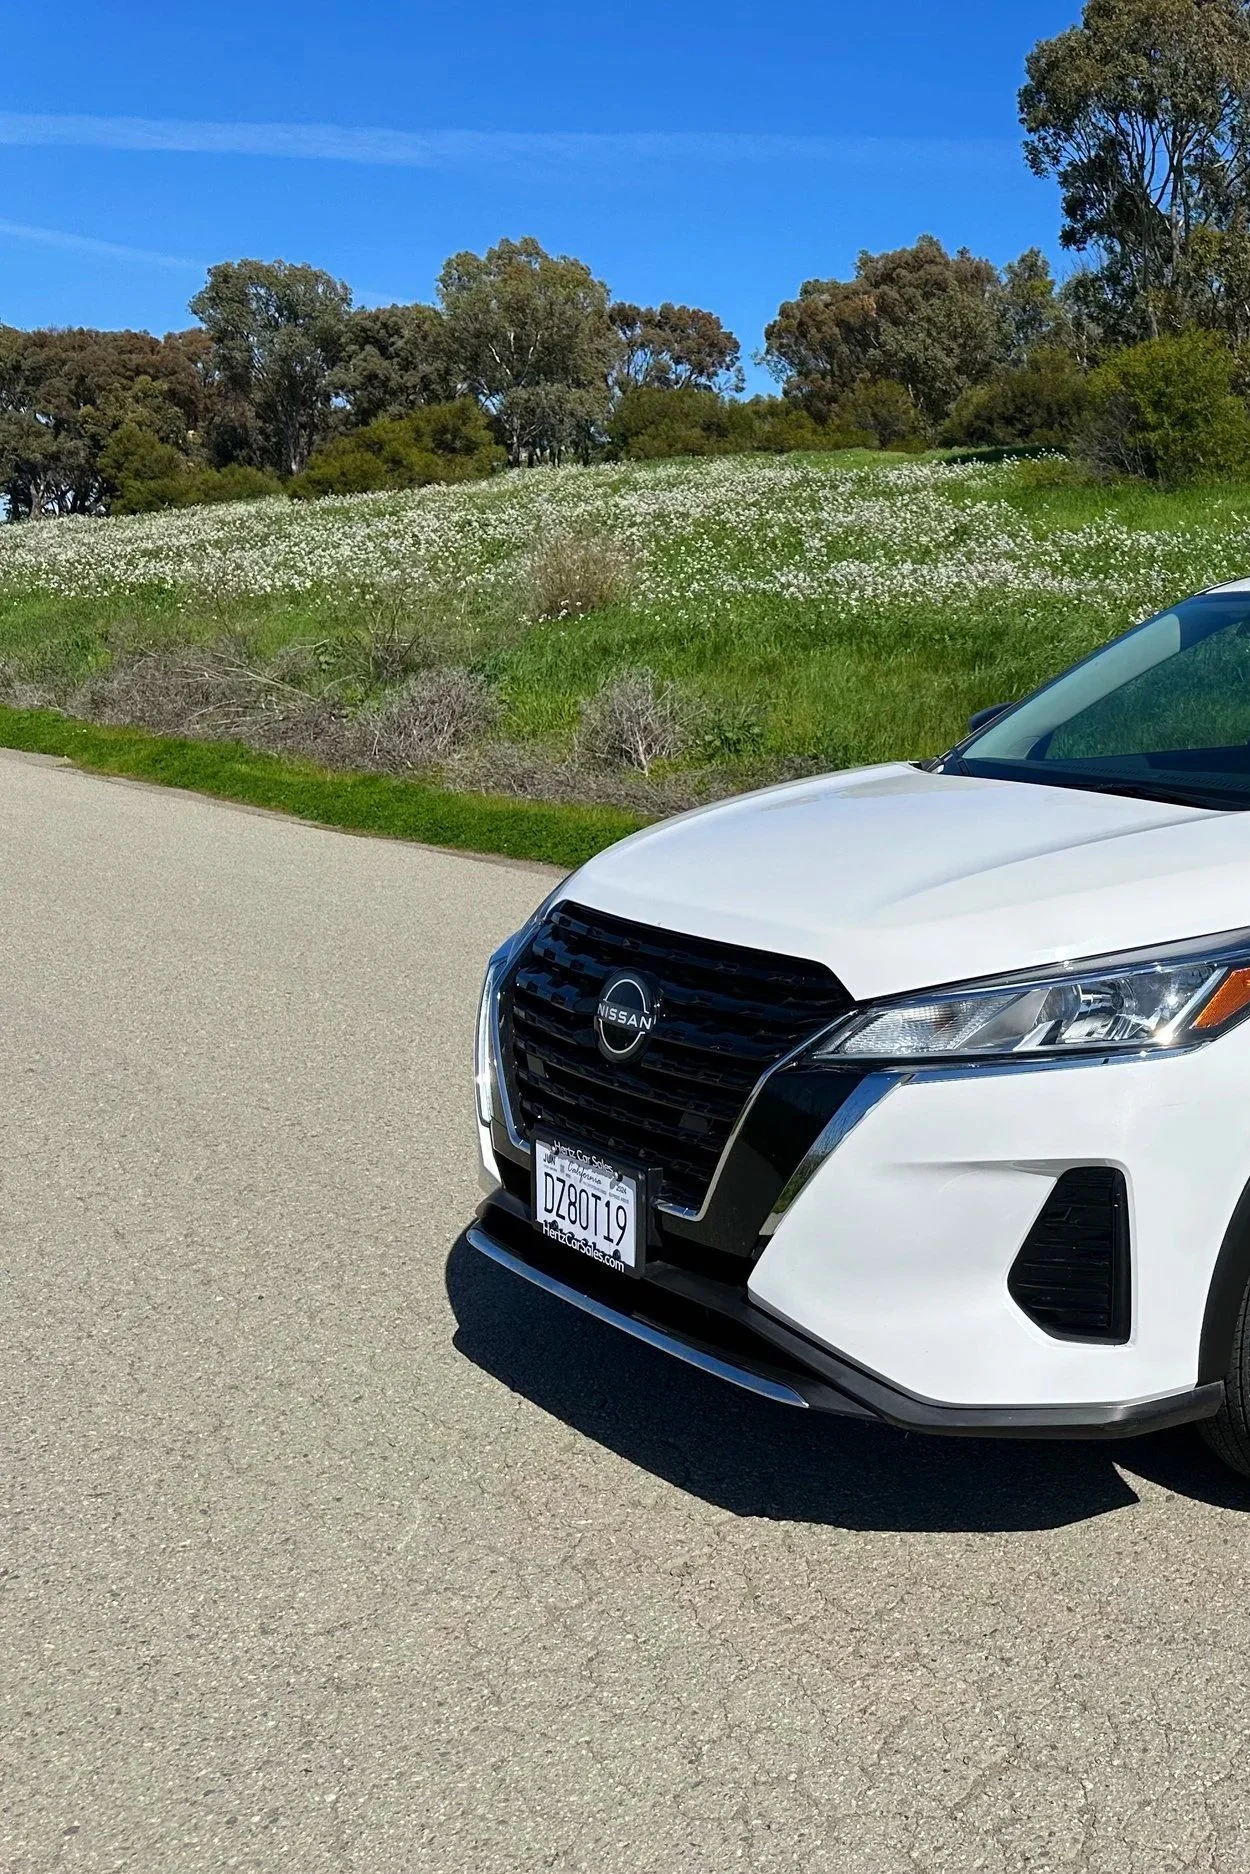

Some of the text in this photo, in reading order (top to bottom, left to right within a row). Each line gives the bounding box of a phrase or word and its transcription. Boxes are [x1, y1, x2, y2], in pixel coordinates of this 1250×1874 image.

[597, 1003, 652, 1030] NISSAN
[543, 1153, 556, 1166] JUN
[553, 1140, 614, 1173] Hertz Car Sales
[567, 1161, 602, 1184] California
[543, 1172, 628, 1246] DZ80T19
[542, 1223, 625, 1273] HertzCarSales.com
